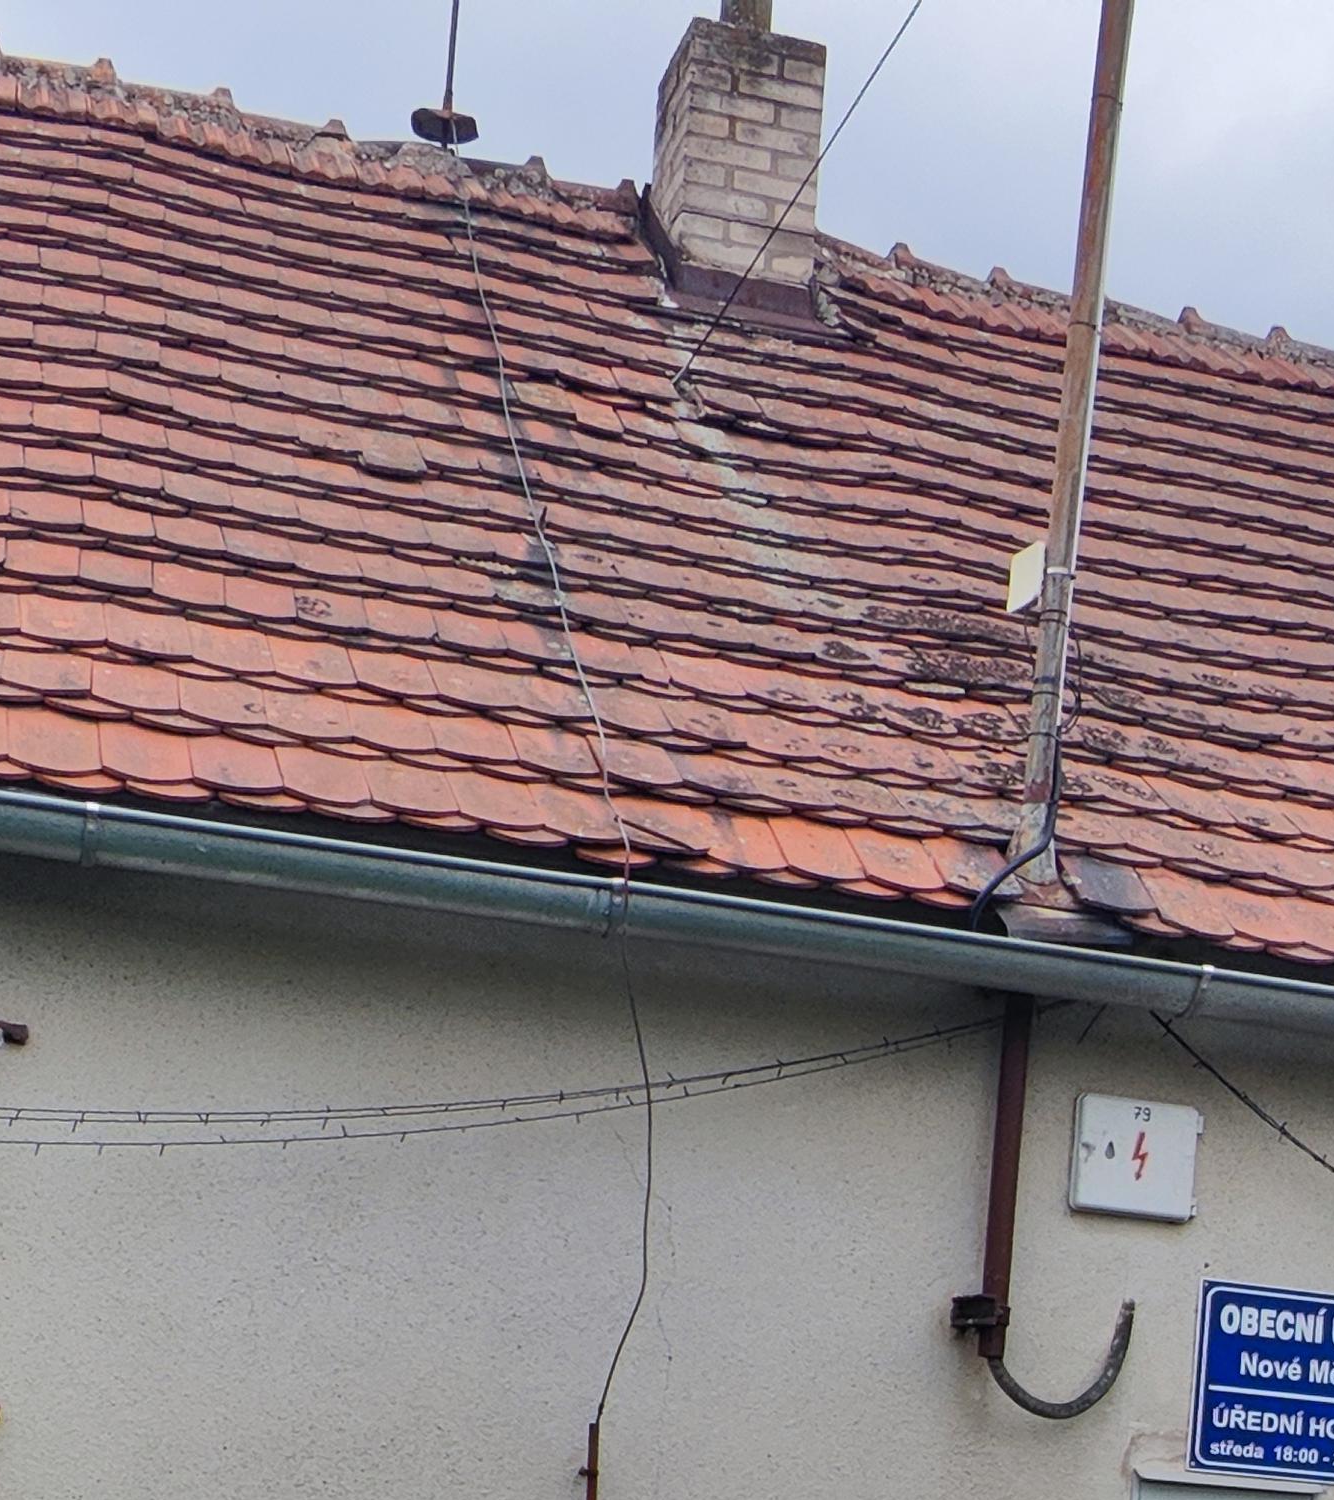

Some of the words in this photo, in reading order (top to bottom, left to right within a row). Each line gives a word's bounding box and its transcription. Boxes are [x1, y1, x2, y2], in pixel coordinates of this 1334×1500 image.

[1133, 1106, 1152, 1122] 79
[1220, 1303, 1328, 1344] OBECNÍ
[1239, 1351, 1303, 1382] Nové
[1212, 1402, 1305, 1436] ÚŘEDNÍ
[1209, 1439, 1265, 1460] středa
[1273, 1445, 1319, 1464] 18:00
